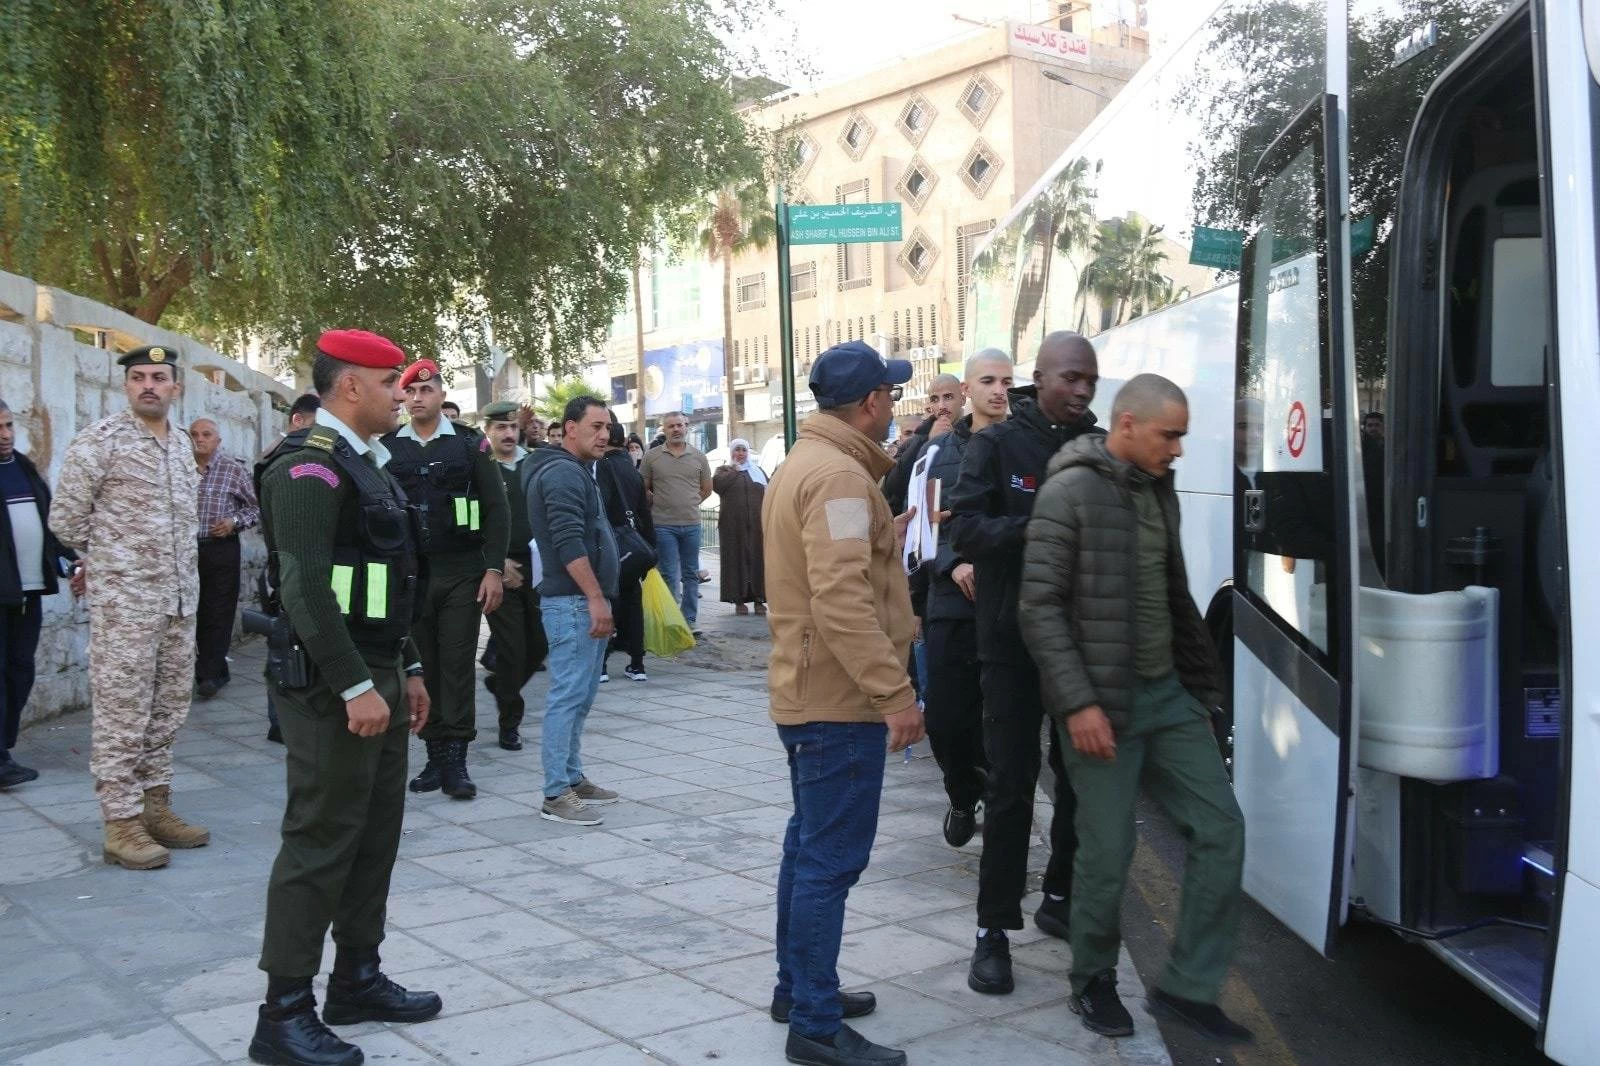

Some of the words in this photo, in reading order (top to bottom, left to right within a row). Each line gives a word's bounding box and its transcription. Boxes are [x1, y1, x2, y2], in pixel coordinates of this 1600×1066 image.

[1014, 25, 1057, 48] كلاسيك
[1059, 35, 1087, 56] فندق
[792, 209, 808, 224] علي
[810, 210, 820, 220] بن
[822, 206, 849, 220] الحسين
[851, 205, 882, 218] الشريف
[791, 229, 804, 240] ASH
[805, 229, 828, 239] SHARIF
[829, 228, 838, 238] AL
[839, 228, 866, 238] HUSSEIN
[867, 227, 878, 237] BIN
[879, 227, 889, 237] ALI
